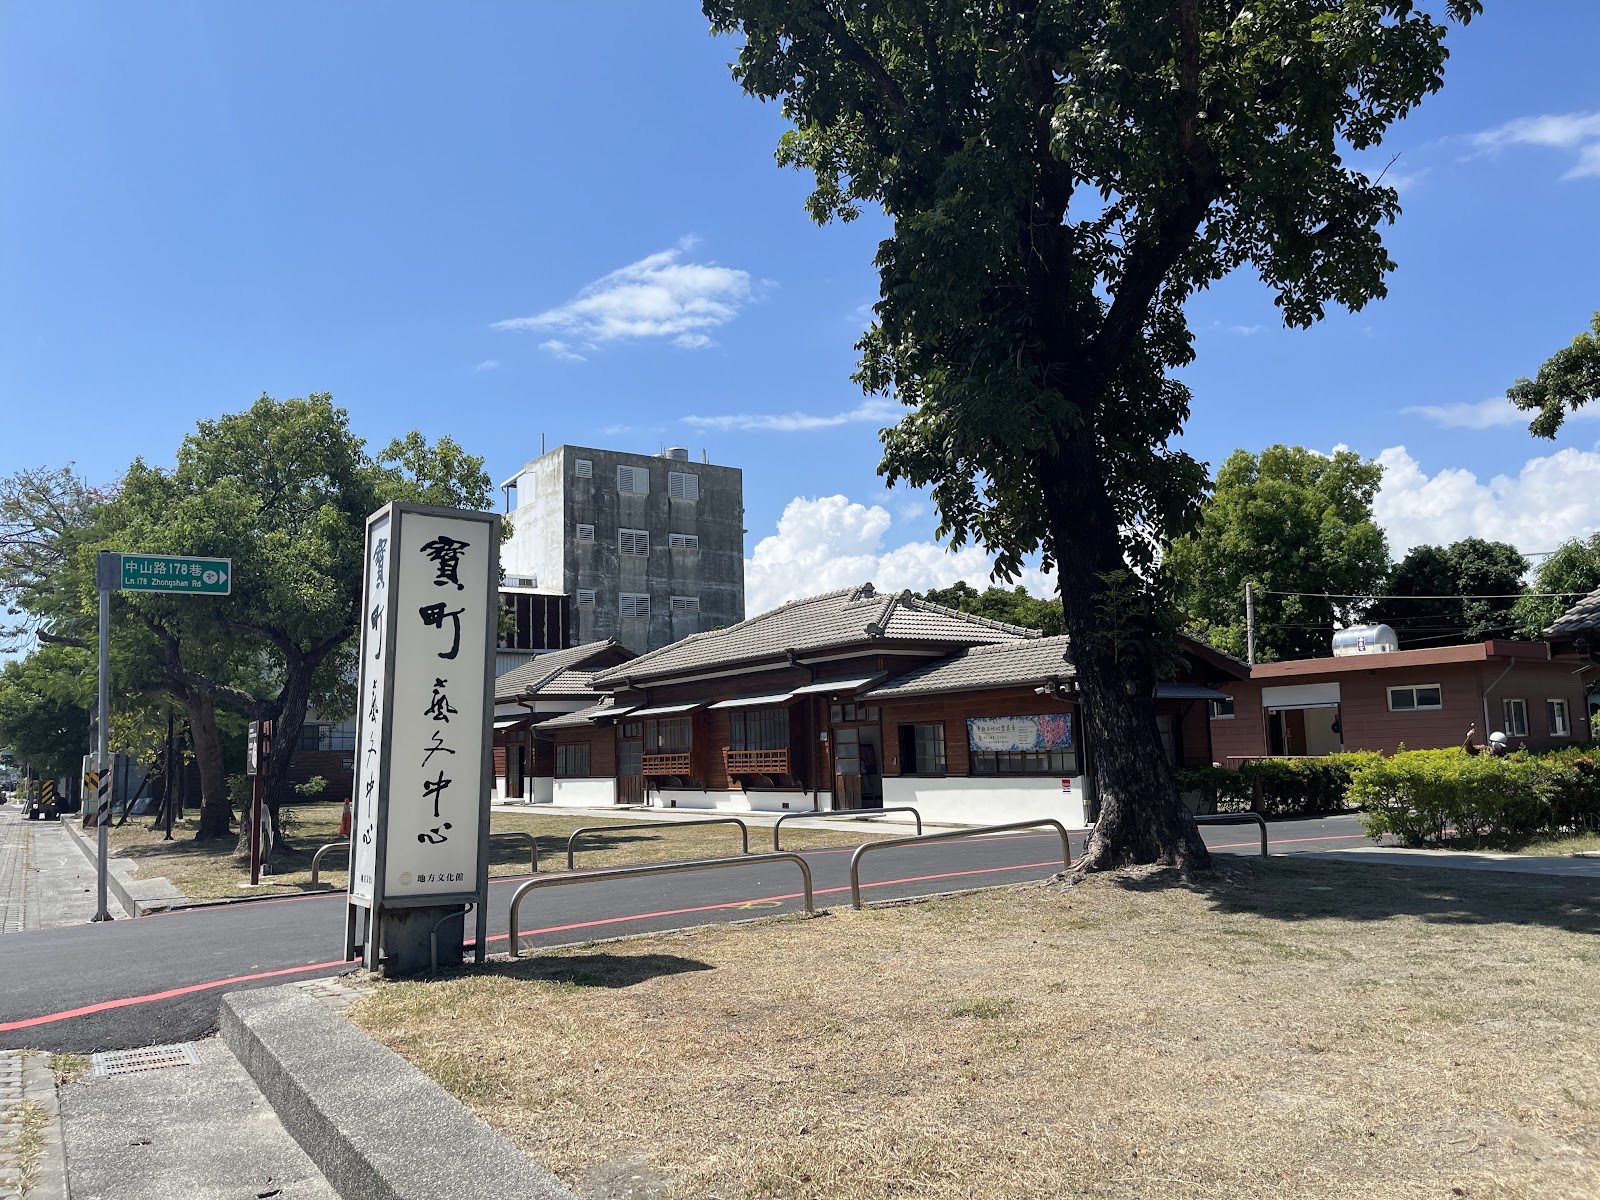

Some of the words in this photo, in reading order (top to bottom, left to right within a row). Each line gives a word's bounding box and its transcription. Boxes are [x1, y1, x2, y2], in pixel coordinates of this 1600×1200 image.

[125, 560, 202, 577] 中山路178巷
[125, 577, 135, 585] Ln
[136, 577, 148, 585] 178
[151, 578, 188, 588] Zhongshan
[418, 535, 470, 845] 寶町藝文中心
[417, 872, 464, 883] 地方文化館
